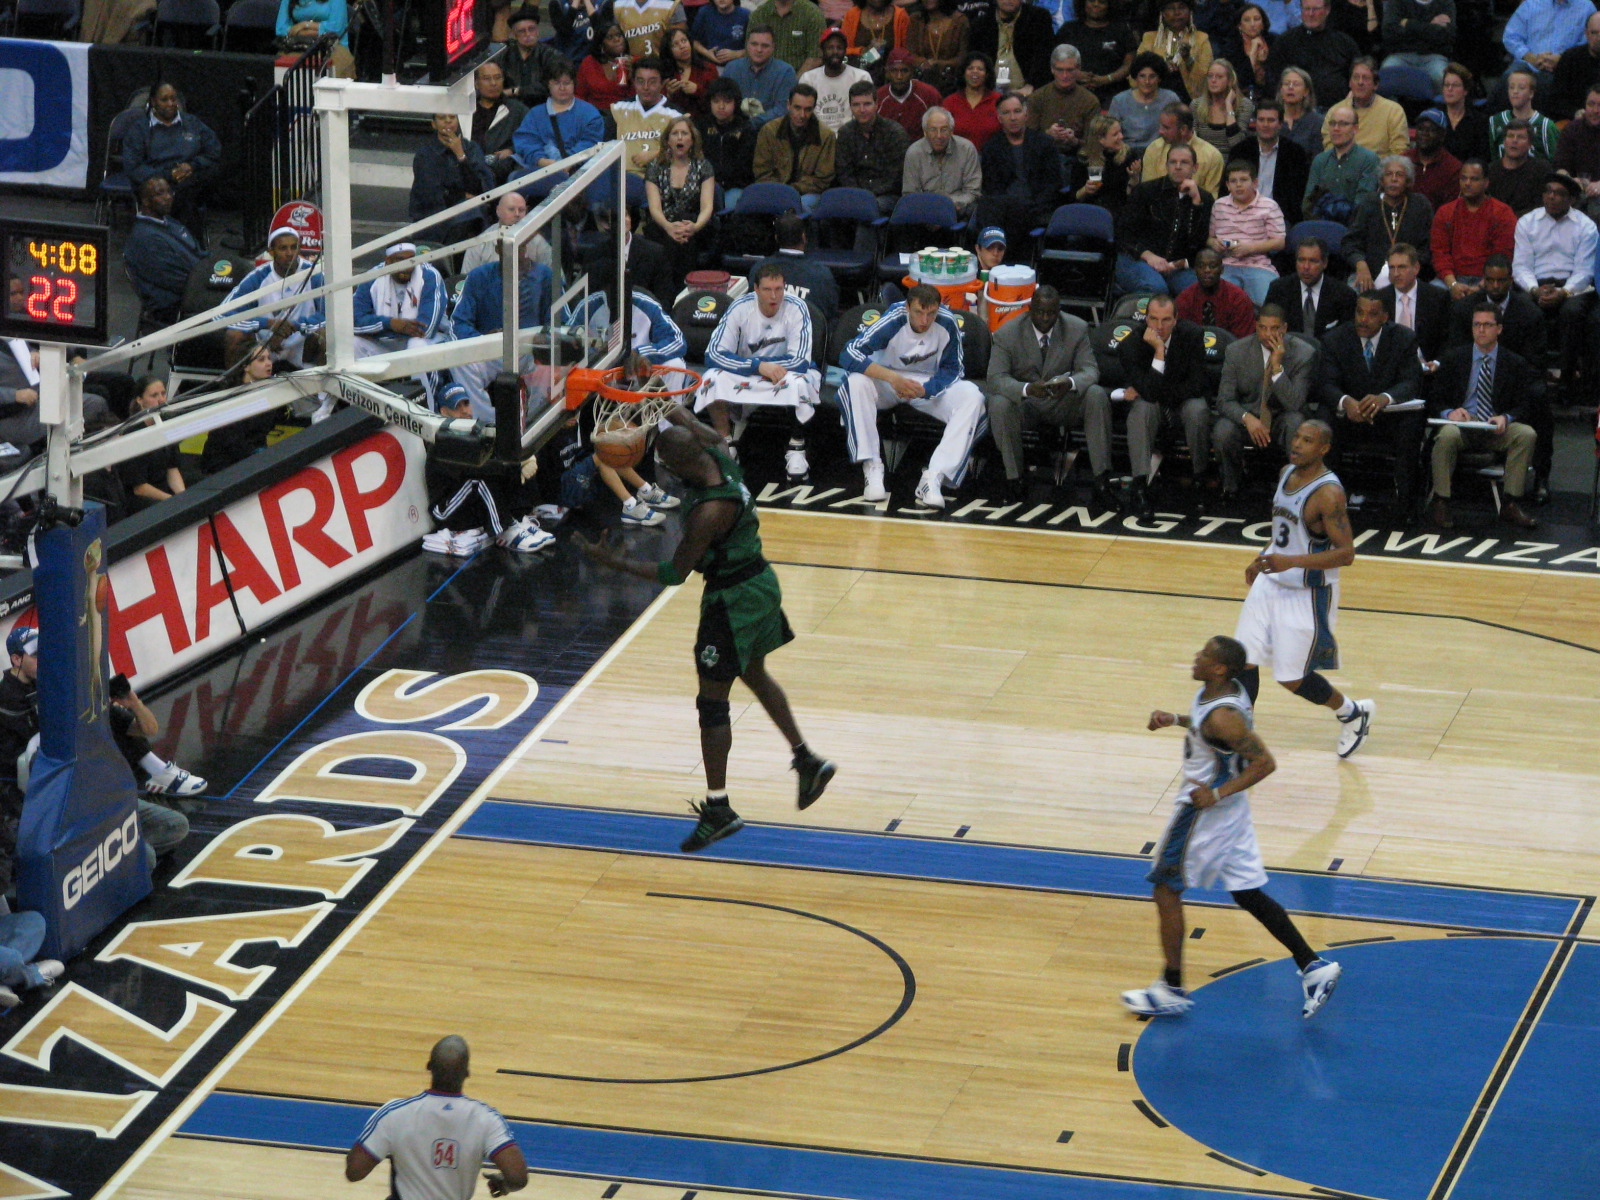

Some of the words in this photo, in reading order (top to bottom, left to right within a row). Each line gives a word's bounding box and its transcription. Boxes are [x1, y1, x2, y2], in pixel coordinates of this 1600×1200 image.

[644, 39, 653, 55] 3
[29, 241, 97, 275] 4:08
[27, 276, 76, 320] 22
[209, 274, 233, 284] Sprite
[692, 310, 718, 320] Sprite
[338, 379, 380, 415] Verizon
[384, 403, 424, 435] Center
[756, 482, 1371, 551] WASHINGT
[1275, 521, 1290, 548] 3
[107, 430, 406, 679] HARP
[62, 809, 138, 910] GEICO
[0, 668, 540, 1200] IZARDS
[434, 1142, 455, 1166] 54
